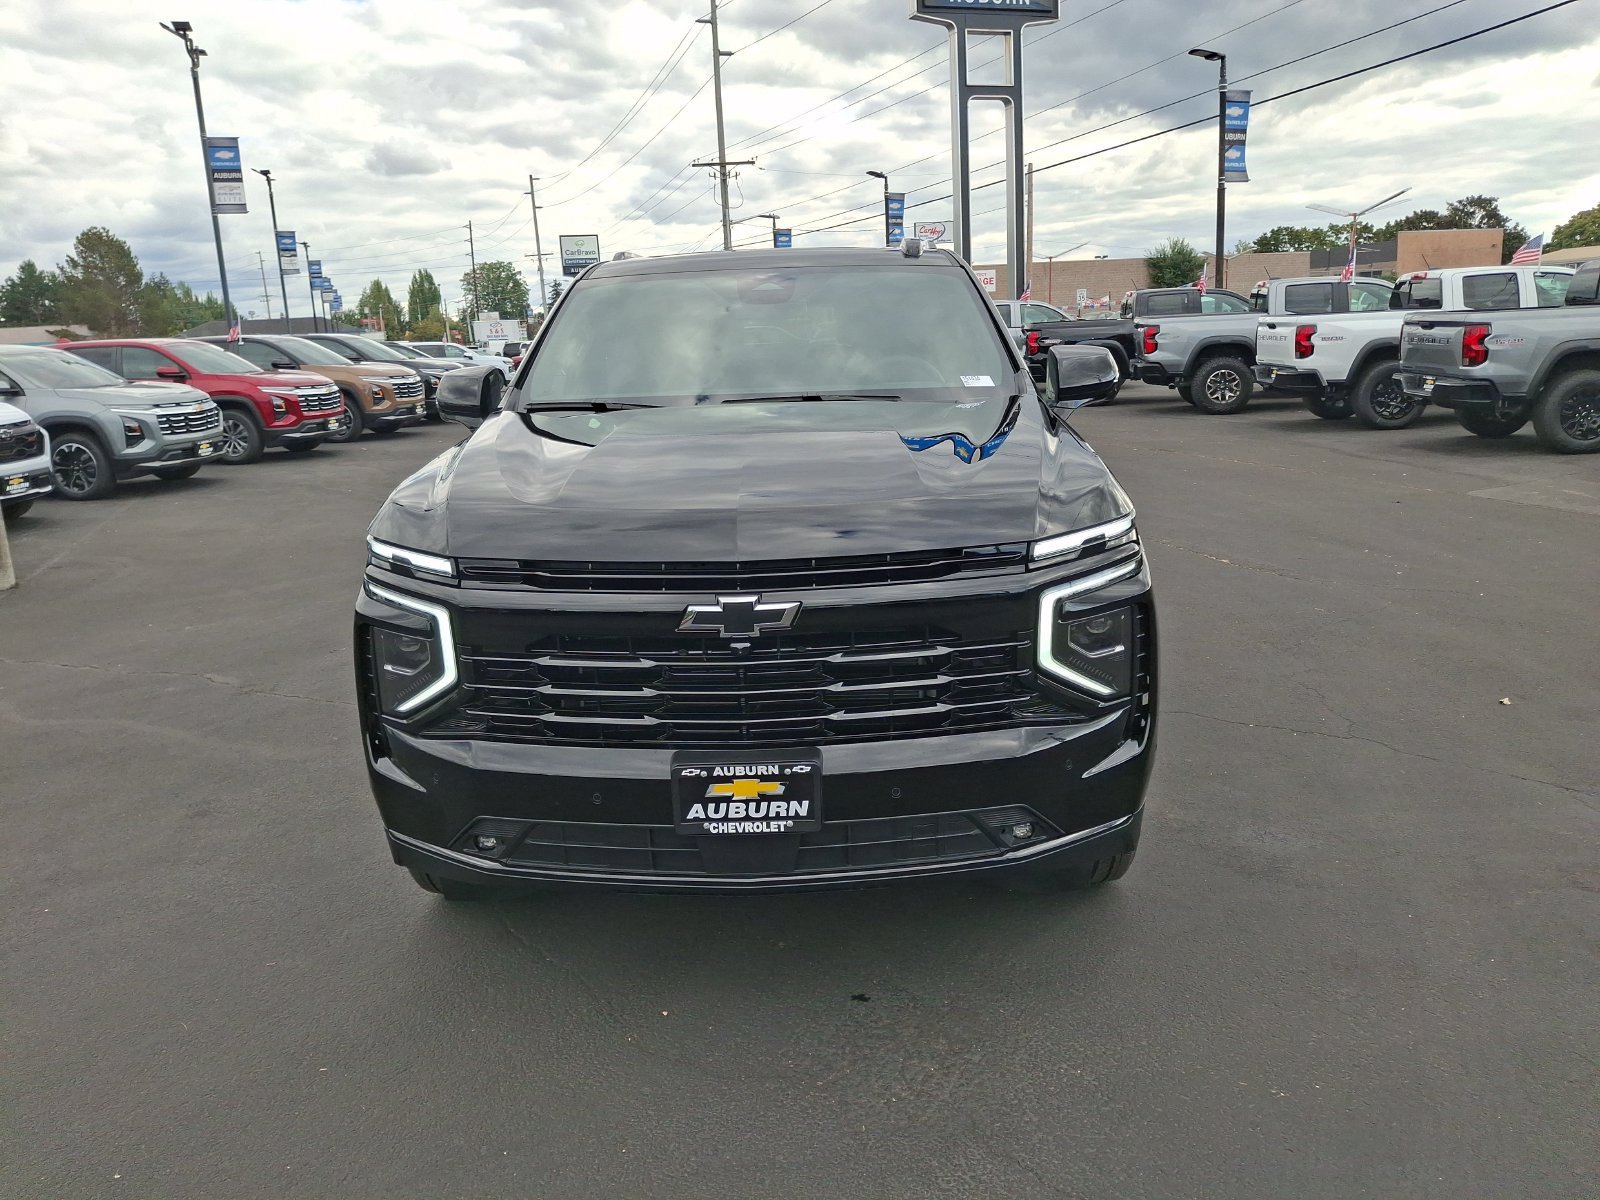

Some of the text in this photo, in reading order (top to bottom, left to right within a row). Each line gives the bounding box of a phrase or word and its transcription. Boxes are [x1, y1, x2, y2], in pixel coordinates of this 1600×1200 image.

[1225, 132, 1246, 140] UBURN
[712, 765, 779, 777] AUBURN
[686, 800, 810, 820] AUBURN
[709, 821, 787, 834] CHEVROLET
